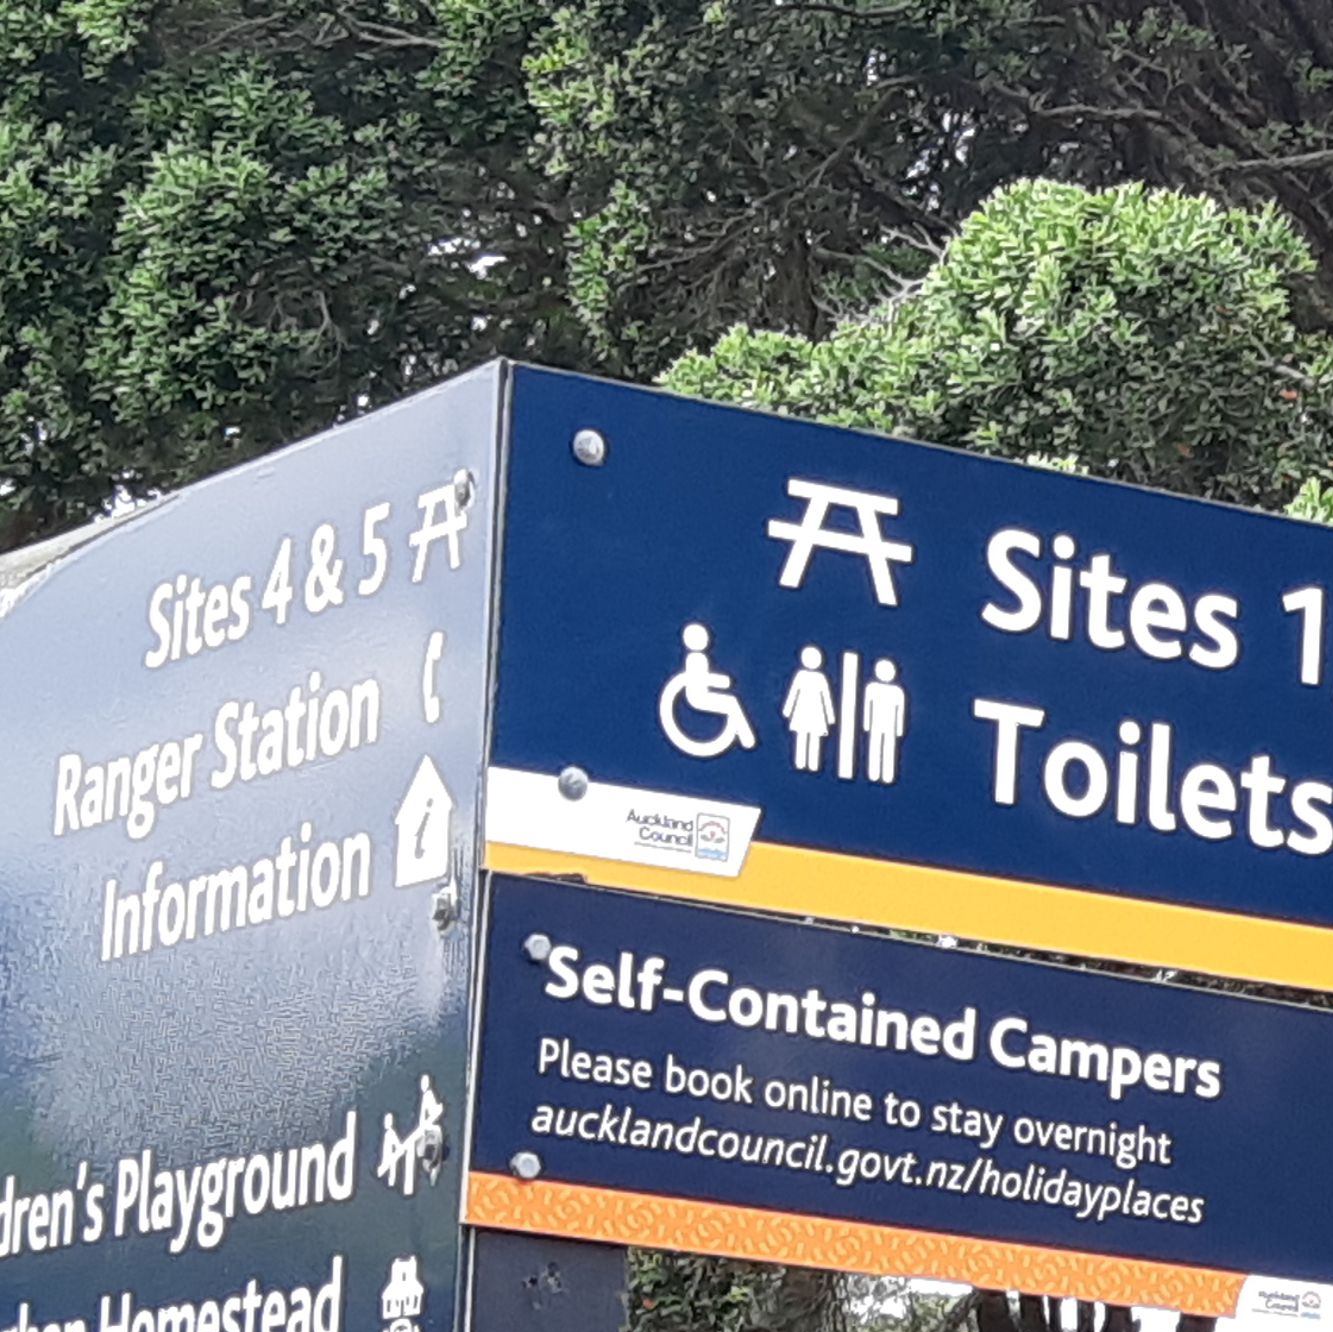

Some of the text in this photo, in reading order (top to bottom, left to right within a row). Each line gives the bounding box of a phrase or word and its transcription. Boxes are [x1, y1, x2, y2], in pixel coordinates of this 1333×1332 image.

[146, 503, 390, 668] Sites 4 & 5
[980, 528, 1238, 669] Sites
[54, 672, 380, 839] Ranger Station
[626, 808, 693, 832] Auckland
[101, 823, 371, 961] Information
[639, 826, 693, 847] Council
[544, 946, 1221, 1099] Self-Contained Campers
[531, 1103, 1205, 1224] aucklandcouncil.govt.nz/holidayplaces
[538, 1037, 1172, 1170] Please book online to stay overnight
[115, 1111, 356, 1252] Playground
